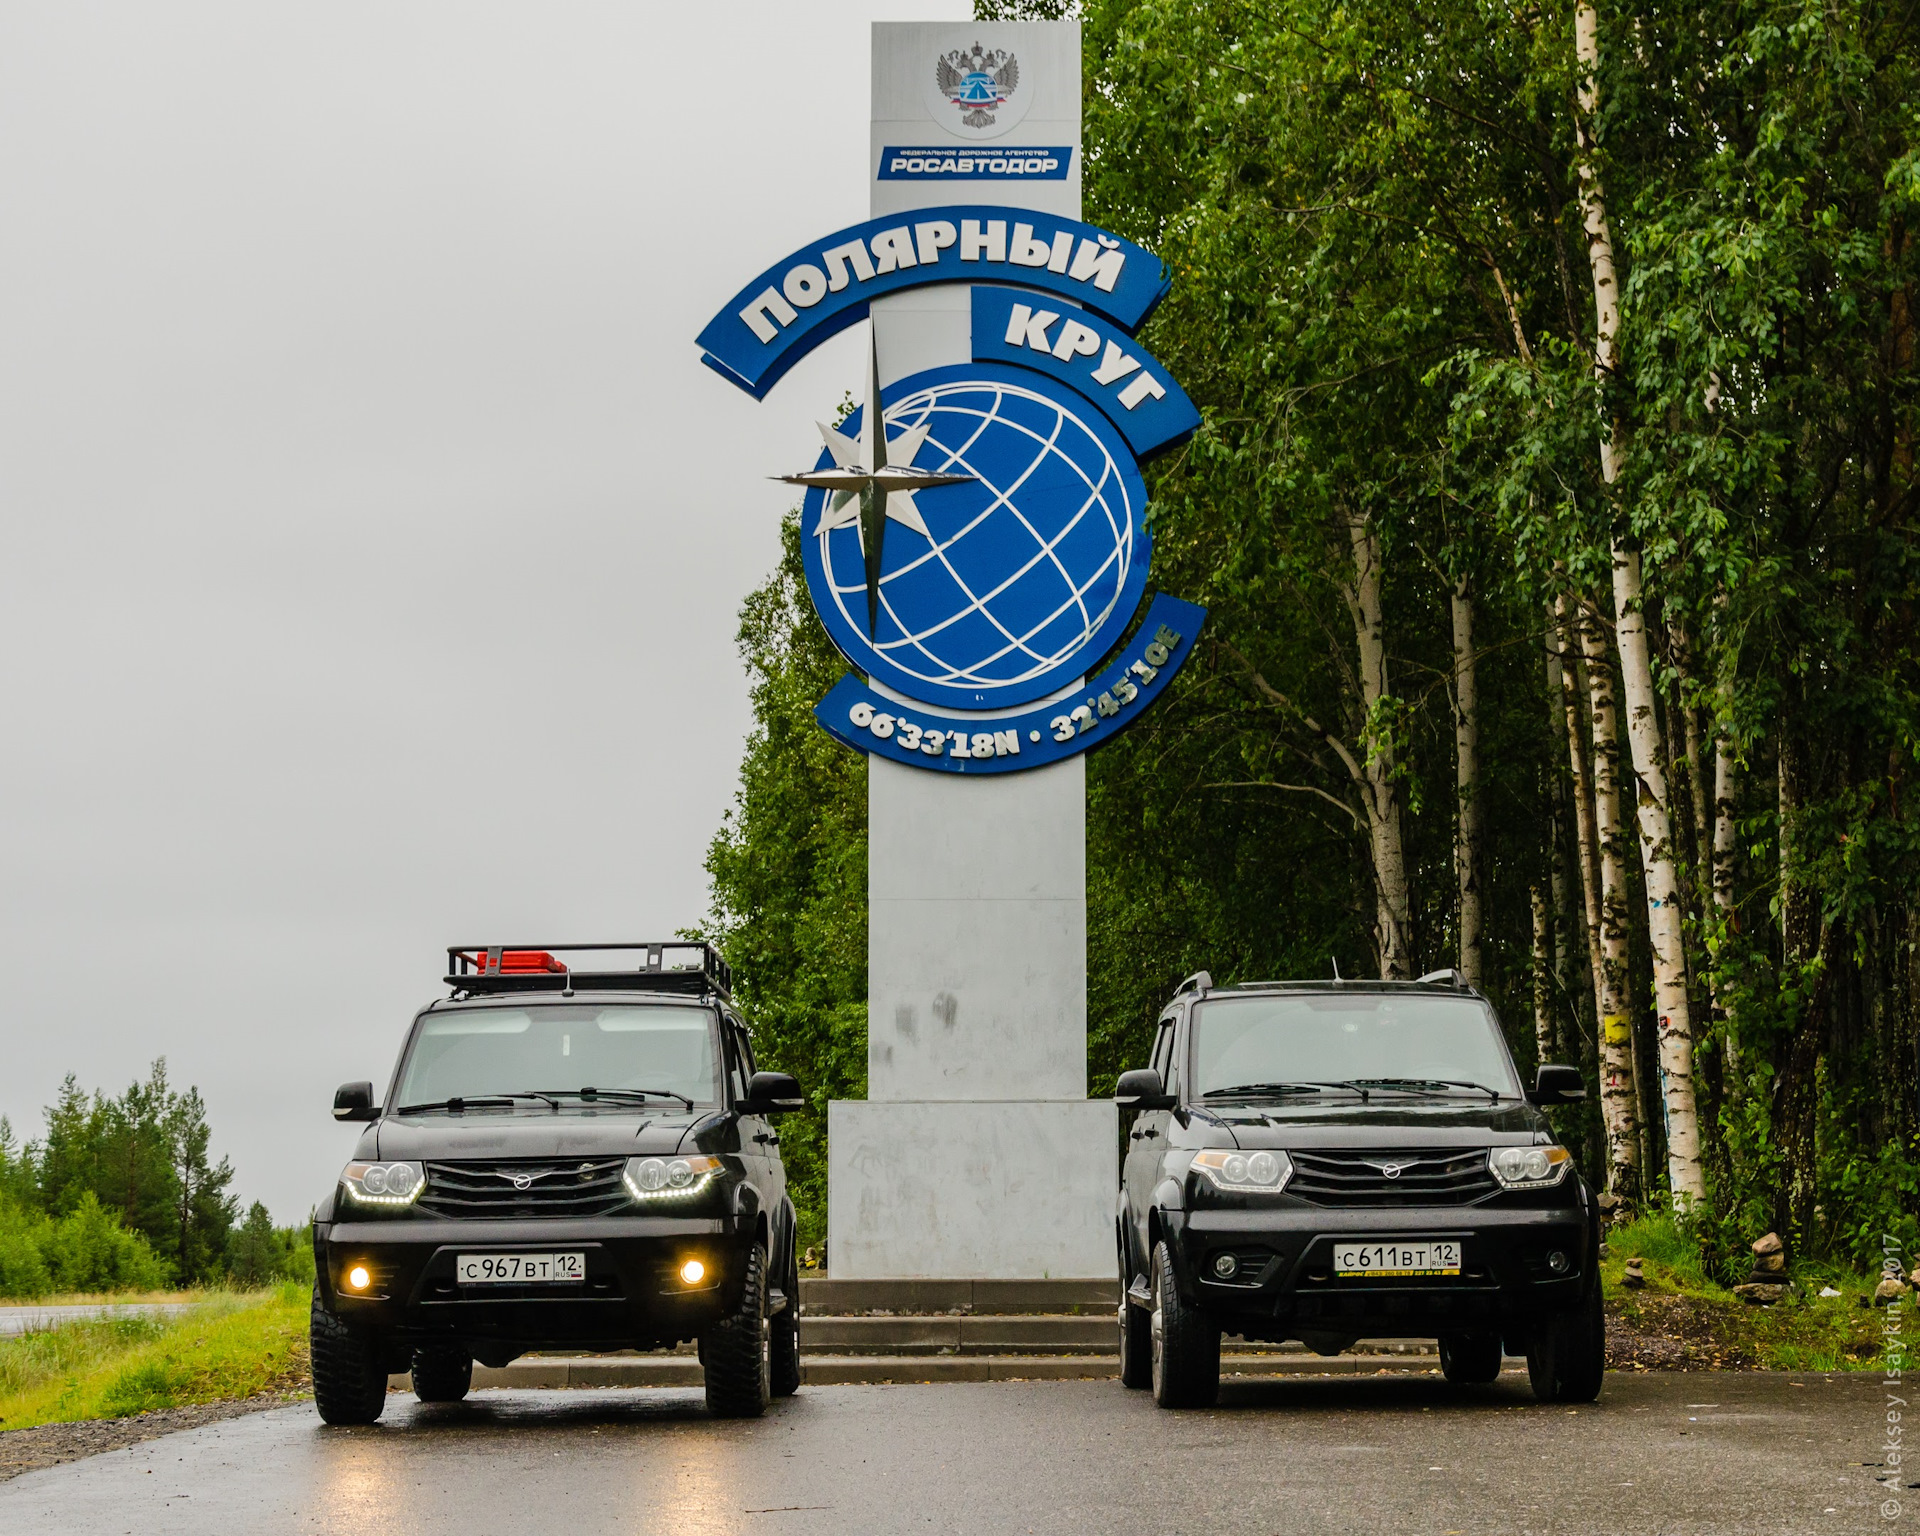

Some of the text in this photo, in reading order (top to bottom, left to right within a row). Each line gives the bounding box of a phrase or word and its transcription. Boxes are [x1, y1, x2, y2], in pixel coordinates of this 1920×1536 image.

[958, 149, 1003, 157] ДОРОЖНОЕ
[890, 158, 1059, 174] РОСАВТОДОР
[738, 219, 1126, 345] ПОЛЯРНЫЙ
[1004, 302, 1167, 411] КРУГ
[1434, 1245, 1453, 1260] 12
[557, 1256, 577, 1271] 12
